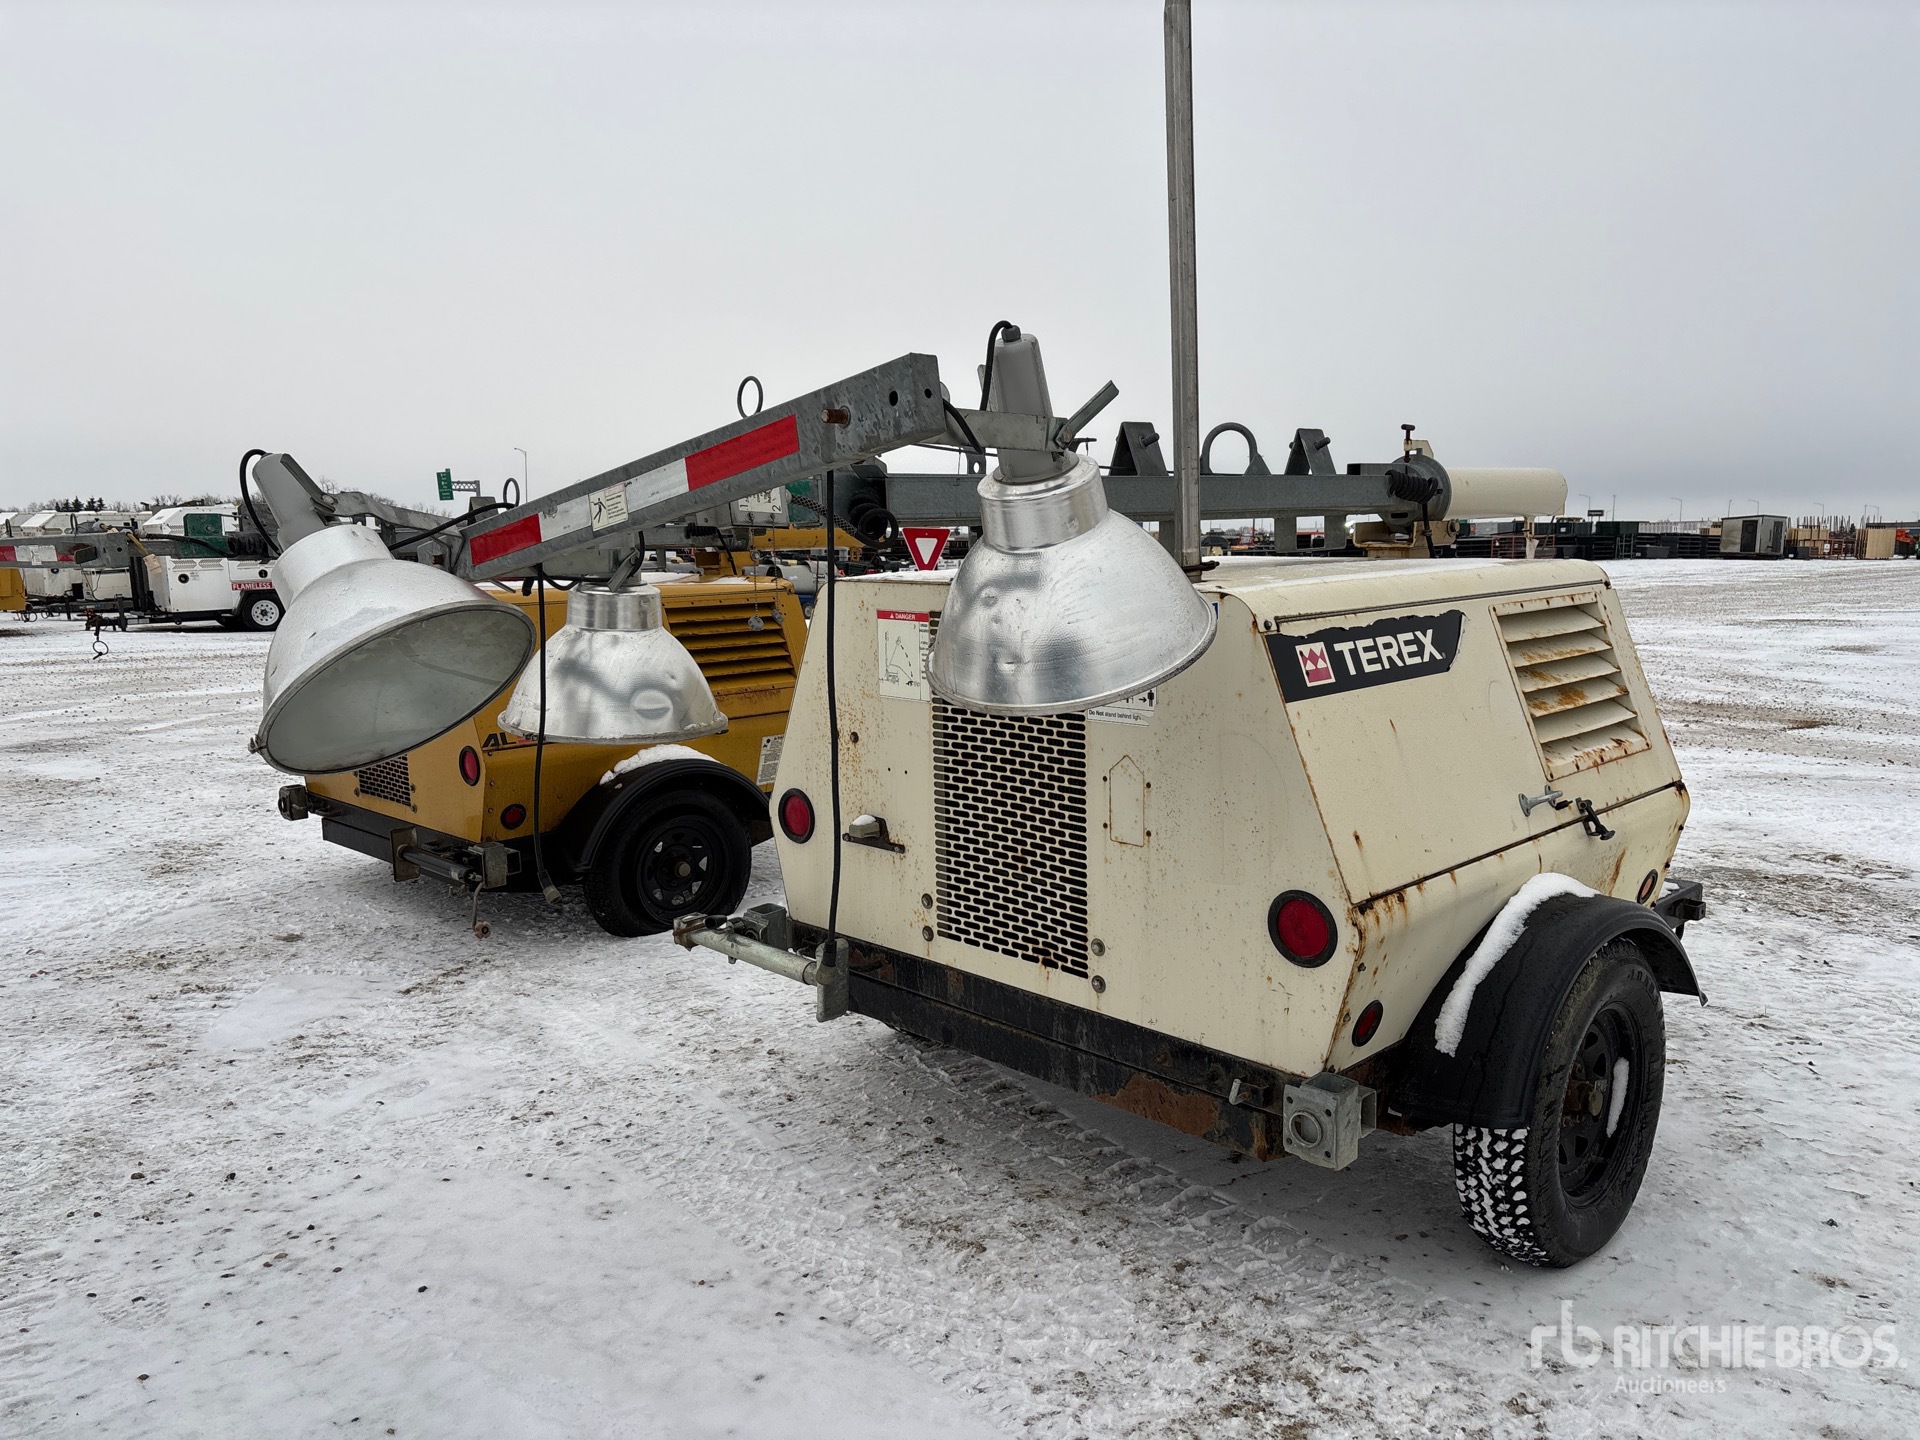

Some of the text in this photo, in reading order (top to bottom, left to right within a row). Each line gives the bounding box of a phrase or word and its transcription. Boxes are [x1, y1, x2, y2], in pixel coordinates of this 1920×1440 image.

[232, 582, 271, 590] FLAMELESS
[1333, 628, 1443, 676] TEREX
[1117, 712, 1132, 720] behind
